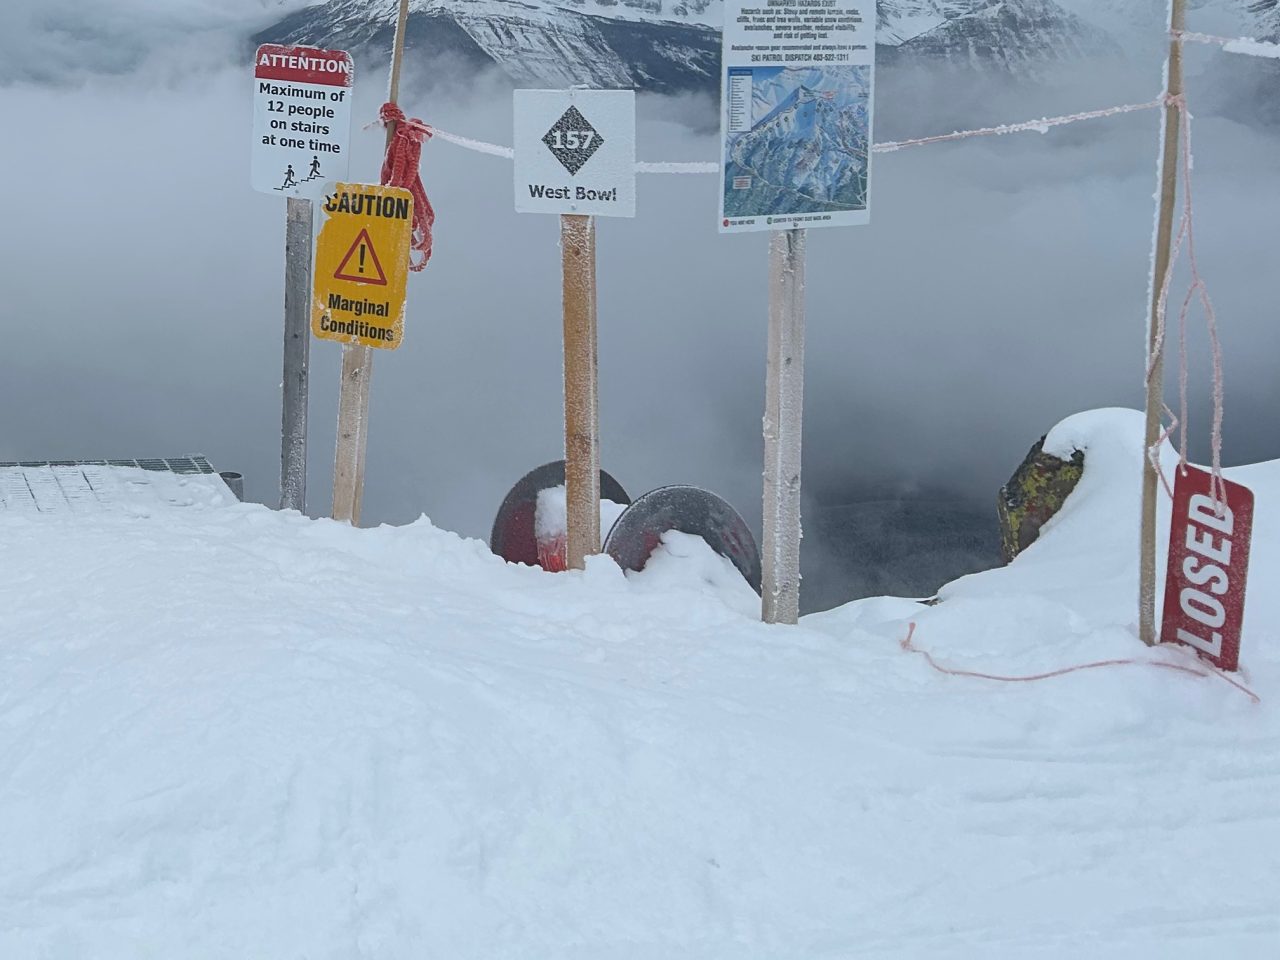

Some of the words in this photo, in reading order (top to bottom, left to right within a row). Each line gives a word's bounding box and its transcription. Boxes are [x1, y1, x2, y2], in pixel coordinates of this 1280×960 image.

[259, 54, 350, 74] ATTENTION
[751, 54, 761, 62] SKI
[259, 82, 326, 100] Maximum
[330, 91, 346, 102] of
[267, 100, 285, 113] 12
[288, 104, 335, 119] people
[270, 119, 287, 130] on
[291, 121, 330, 135] stairs
[262, 135, 277, 146] at
[280, 137, 305, 149] one
[309, 139, 341, 154] time
[551, 130, 595, 150] 157
[528, 184, 571, 200] West
[576, 186, 617, 202] Bowl
[325, 192, 410, 220] CAUTION
[328, 293, 390, 317] Marginal
[320, 315, 394, 342] Conditions
[1176, 493, 1235, 658] LOSED
